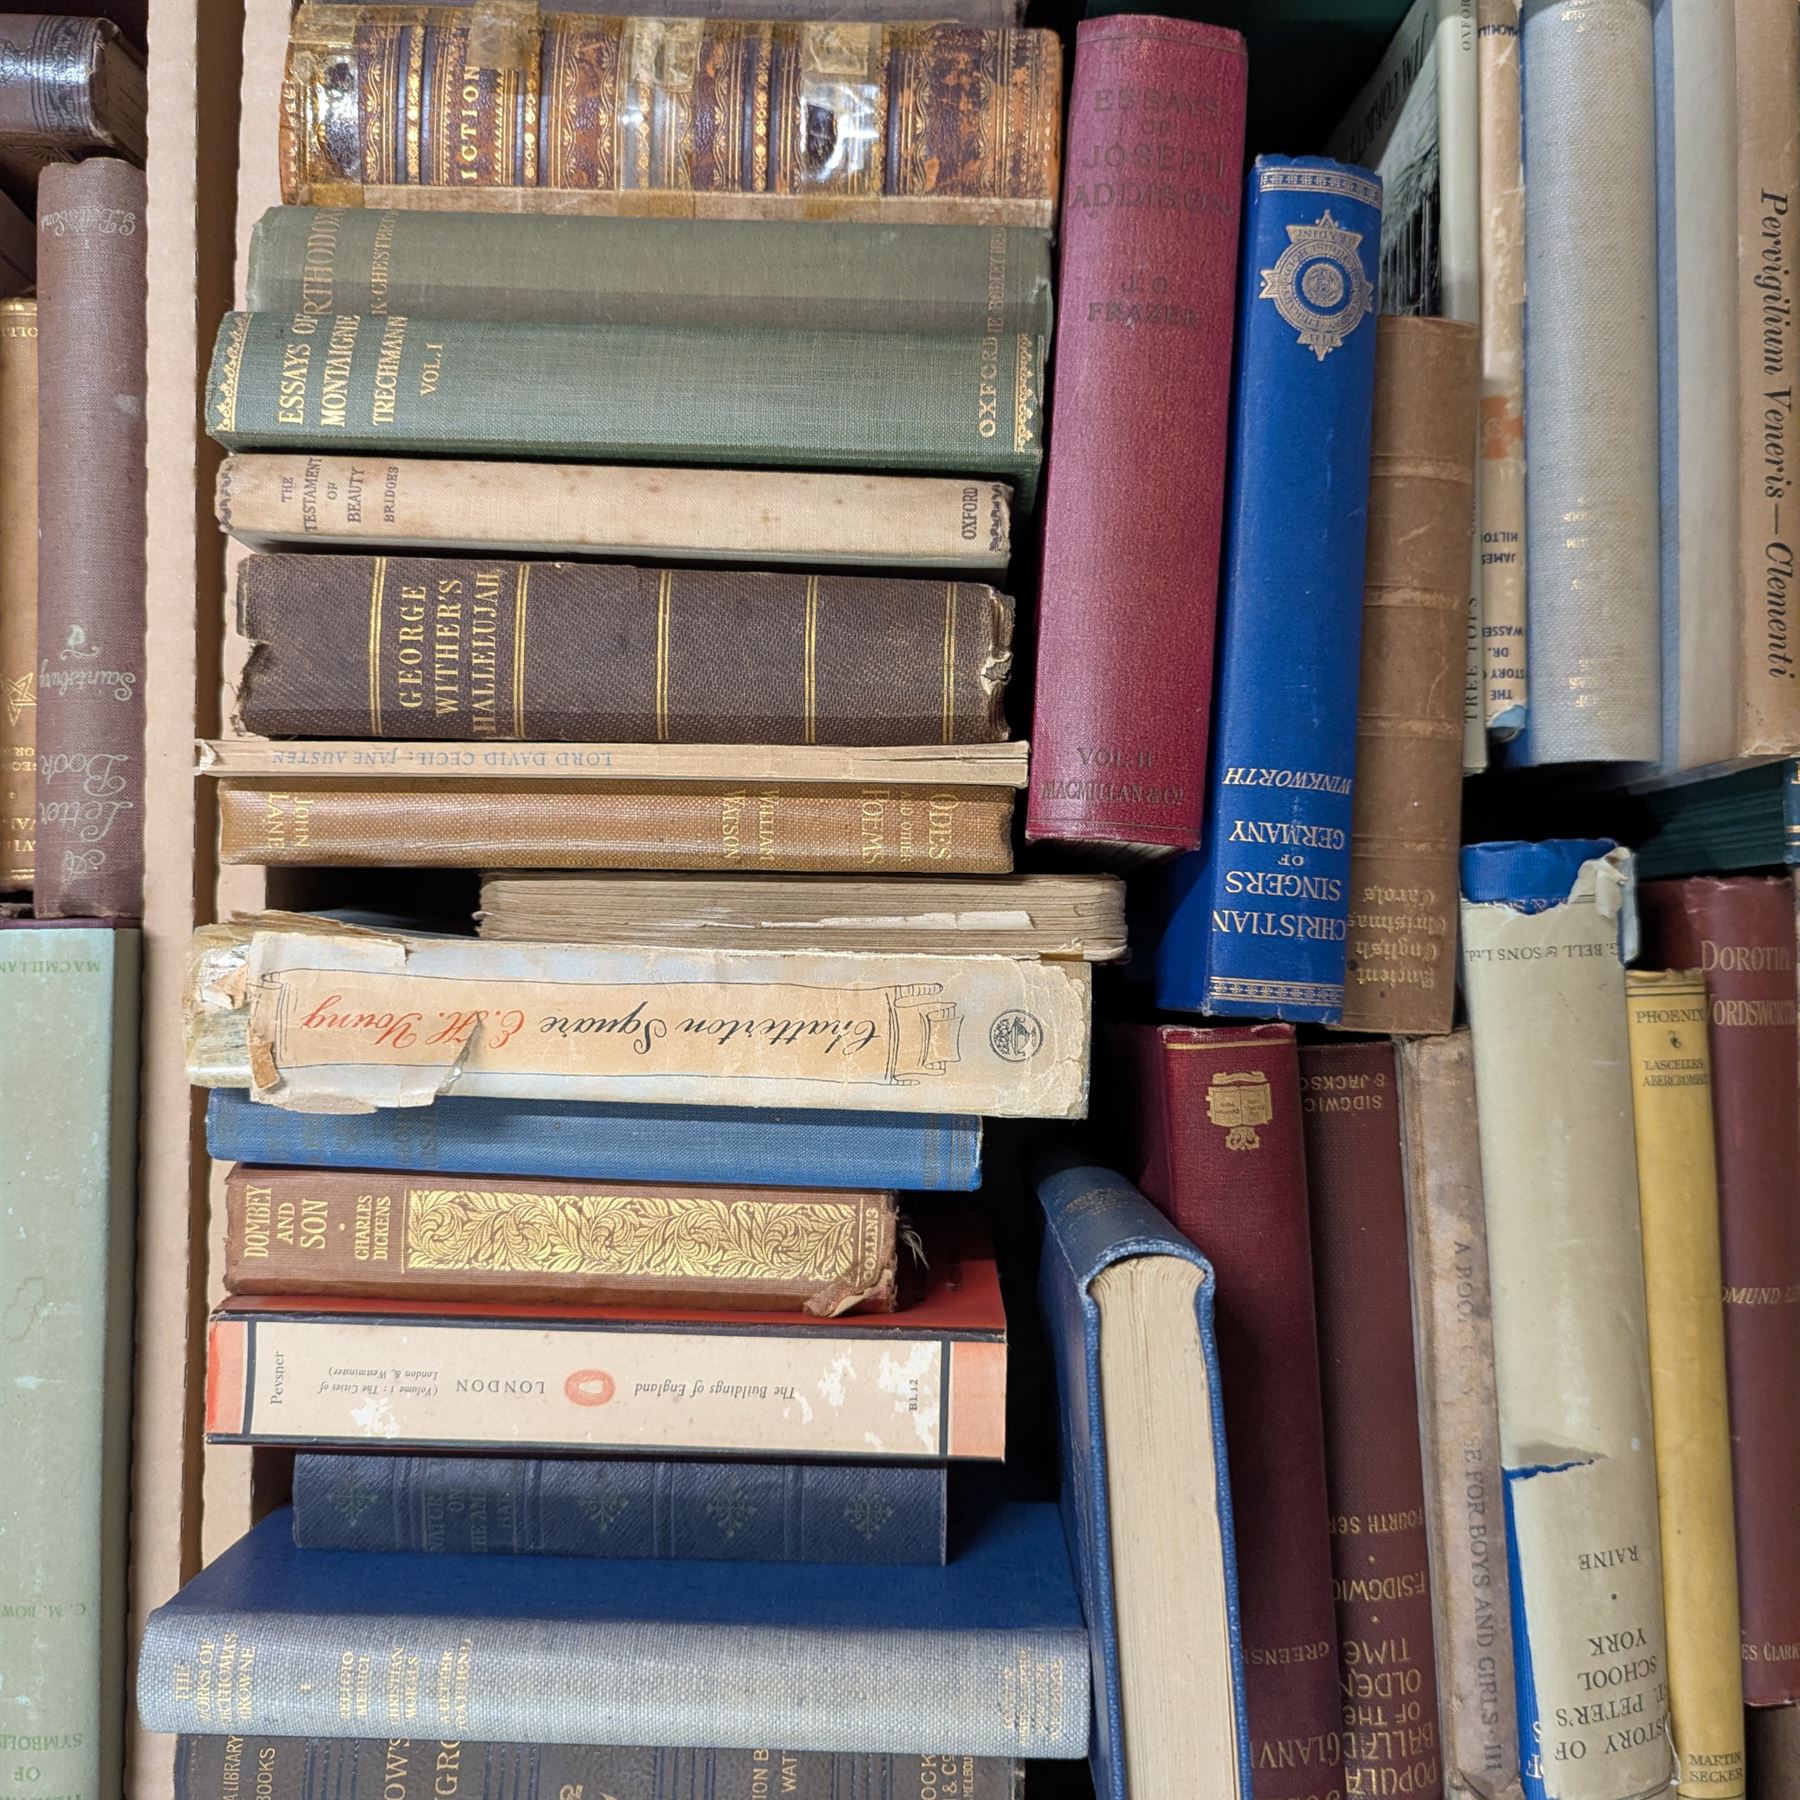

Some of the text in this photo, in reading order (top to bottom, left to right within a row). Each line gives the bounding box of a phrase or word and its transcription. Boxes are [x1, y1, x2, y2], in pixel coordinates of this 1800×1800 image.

[1093, 88, 1219, 118] ESSAYS
[1081, 144, 1225, 178] JOSEPH
[1068, 183, 1233, 217] ADDISON
[1753, 187, 1790, 375] Pervigilium
[1088, 301, 1202, 330] FRAZER
[279, 313, 319, 424] ESSAYS OF
[321, 314, 361, 428] MONTAIGNE
[373, 315, 408, 426] TRECHMANN
[978, 335, 998, 438] OXFORD
[281, 477, 294, 503] THE
[303, 458, 322, 532] TESTAMENT
[327, 482, 338, 501] OF
[347, 466, 365, 523] BEAUTY
[384, 466, 399, 523] BRIDGES
[961, 487, 978, 541] OXFORD
[1480, 531, 1519, 544] HILTO
[1481, 551, 1516, 565] JAMES
[398, 586, 426, 708] GEORGE
[435, 579, 462, 717] WITHER'S
[1488, 647, 1510, 658] DR.
[40, 659, 136, 701] Saintsbury
[1491, 668, 1524, 680] STORY
[1490, 690, 1513, 700] THE
[41, 753, 129, 796] Book
[272, 748, 613, 767] LORD DAVID CECIL: JANE AUSTEN
[1040, 780, 1141, 803] MACMILLAN
[1222, 767, 1352, 795] WINKWORTH
[39, 800, 134, 842] Letter
[269, 793, 290, 849] LANE
[295, 797, 314, 848] JOHN
[722, 789, 746, 860] WATSON
[759, 788, 780, 861] WILLIAM
[861, 790, 889, 863] POEMS
[900, 791, 913, 863] AND OTHER
[928, 793, 959, 860] ODES
[1228, 820, 1345, 850] GERMANY
[1277, 854, 1305, 867] OF
[1225, 870, 1341, 902] SINGERS
[1362, 886, 1435, 907] Carols
[1212, 909, 1346, 941] CHRISTIAN
[1347, 911, 1446, 936] Christmas
[1354, 936, 1437, 961] English
[1465, 943, 1603, 962] BELL & SONS Ltd.
[299, 994, 881, 1056] Chatterton Square E. H. Young
[1642, 1057, 1704, 1070] LASCELLES
[1300, 1072, 1386, 1091] & JACKSO
[1303, 1094, 1383, 1112] SIDGWIC
[244, 1184, 272, 1258] DOMBEY
[277, 1202, 295, 1246] AND
[300, 1198, 328, 1250] SON
[354, 1194, 373, 1261] CHARLES
[373, 1195, 391, 1261] DICKENS
[864, 1207, 879, 1281] COLLINS
[1453, 1240, 1472, 1256] A
[1455, 1264, 1475, 1321] BOO
[270, 1350, 285, 1405] Pevsner
[317, 1381, 438, 1397] (Volume The Cities of
[328, 1366, 438, 1381] London & Westminster)
[456, 1379, 545, 1395] LONDON
[634, 1379, 797, 1401] The Buildings of England
[1465, 1470, 1486, 1520] FOR
[1368, 1508, 1423, 1534] FOURTH
[1468, 1524, 1492, 1588] BOYS
[1577, 1544, 1639, 1571] RAINE
[1333, 1571, 1426, 1602] F.SIDGWIC
[43, 1604, 63, 1617] M.
[70, 1602, 87, 1616] C.
[1473, 1599, 1495, 1648] AND
[201, 1638, 217, 1665] OF
[1343, 1637, 1411, 1664] TIME
[1586, 1627, 1647, 1657] YORK
[175, 1664, 191, 1702] THE
[218, 1632, 238, 1706] THOMAS
[237, 1646, 256, 1720] BROWNE
[340, 1651, 354, 1720] RELIGIO
[1576, 1655, 1657, 1691] SCHOOL
[1342, 1700, 1421, 1726] OF THE
[1555, 1693, 1644, 1728] PETER'S
[223, 1735, 244, 1791] LIBRARY
[1250, 1731, 1341, 1769] GLANVI
[1484, 1743, 1503, 1773] III
[1553, 1739, 1587, 1761] OF
[1687, 1751, 1742, 1767] MARTIN
[14, 1766, 41, 1782] OF
[781, 1750, 797, 1792] WAT
[942, 1781, 957, 1793] &
[1344, 1756, 1438, 1796] POPULA
[1689, 1767, 1744, 1784] SECKER
